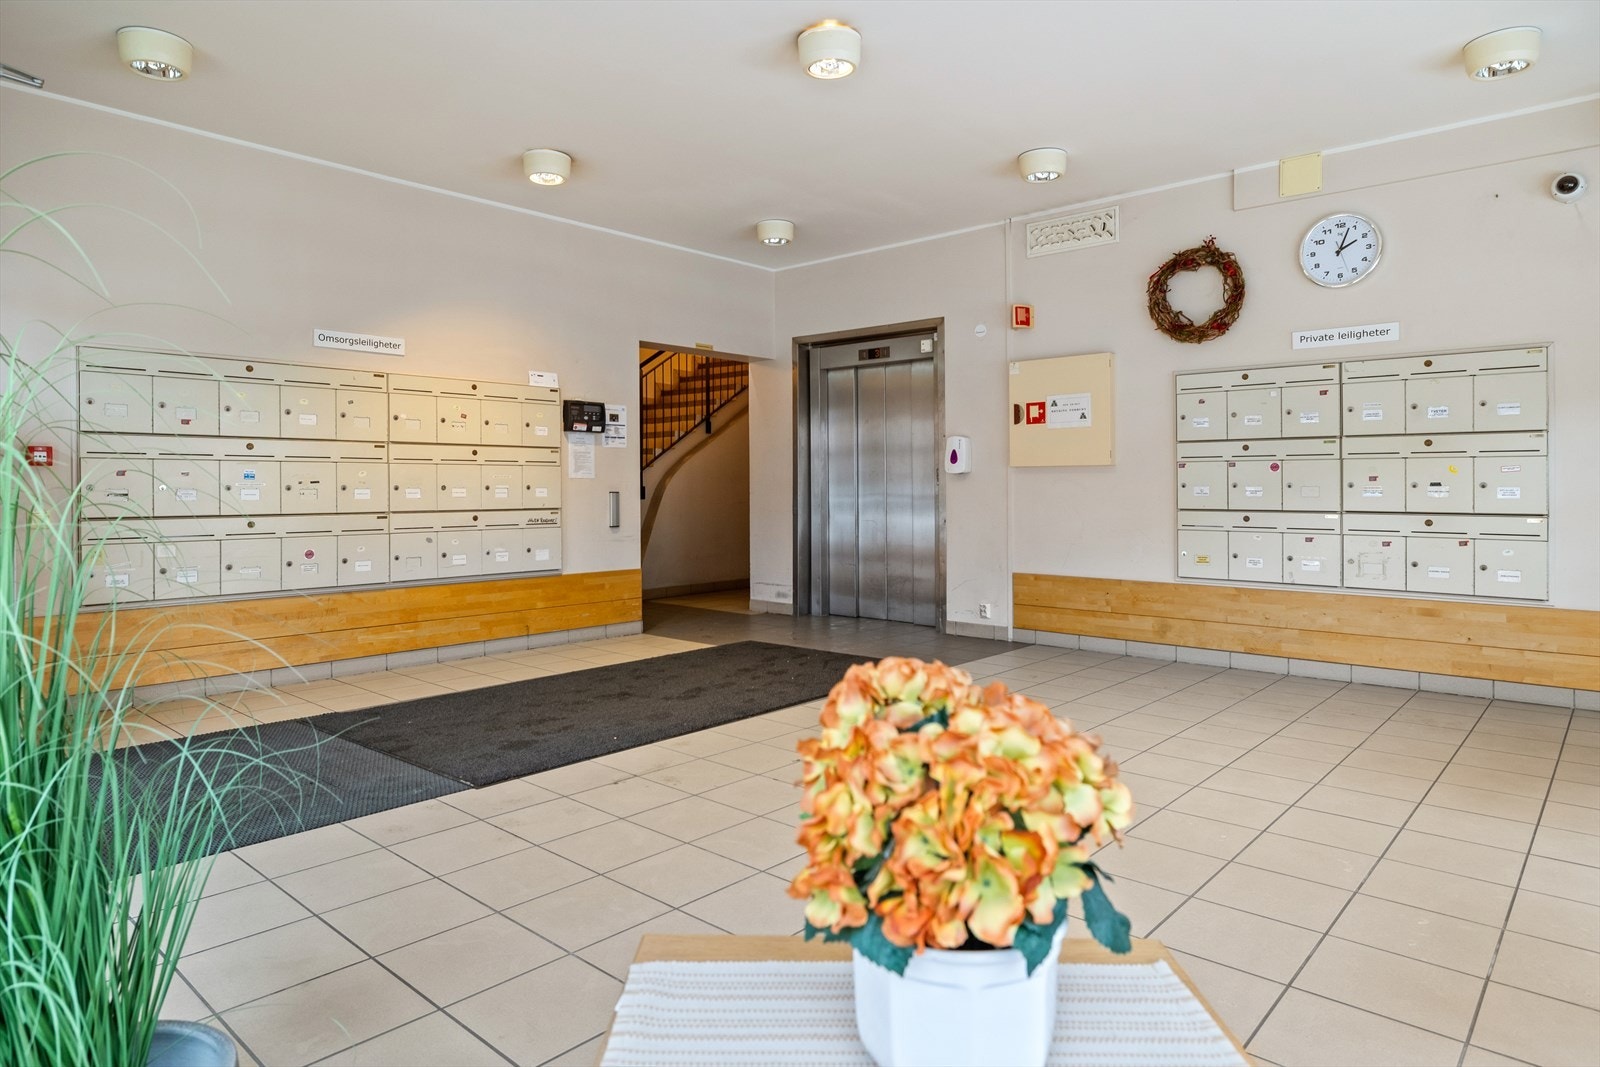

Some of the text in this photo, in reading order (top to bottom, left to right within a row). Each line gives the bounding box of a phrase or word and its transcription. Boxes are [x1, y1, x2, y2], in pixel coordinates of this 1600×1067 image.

[318, 333, 402, 349] Omsorgsleiligheter
[1299, 328, 1391, 344] Private leiligheter
